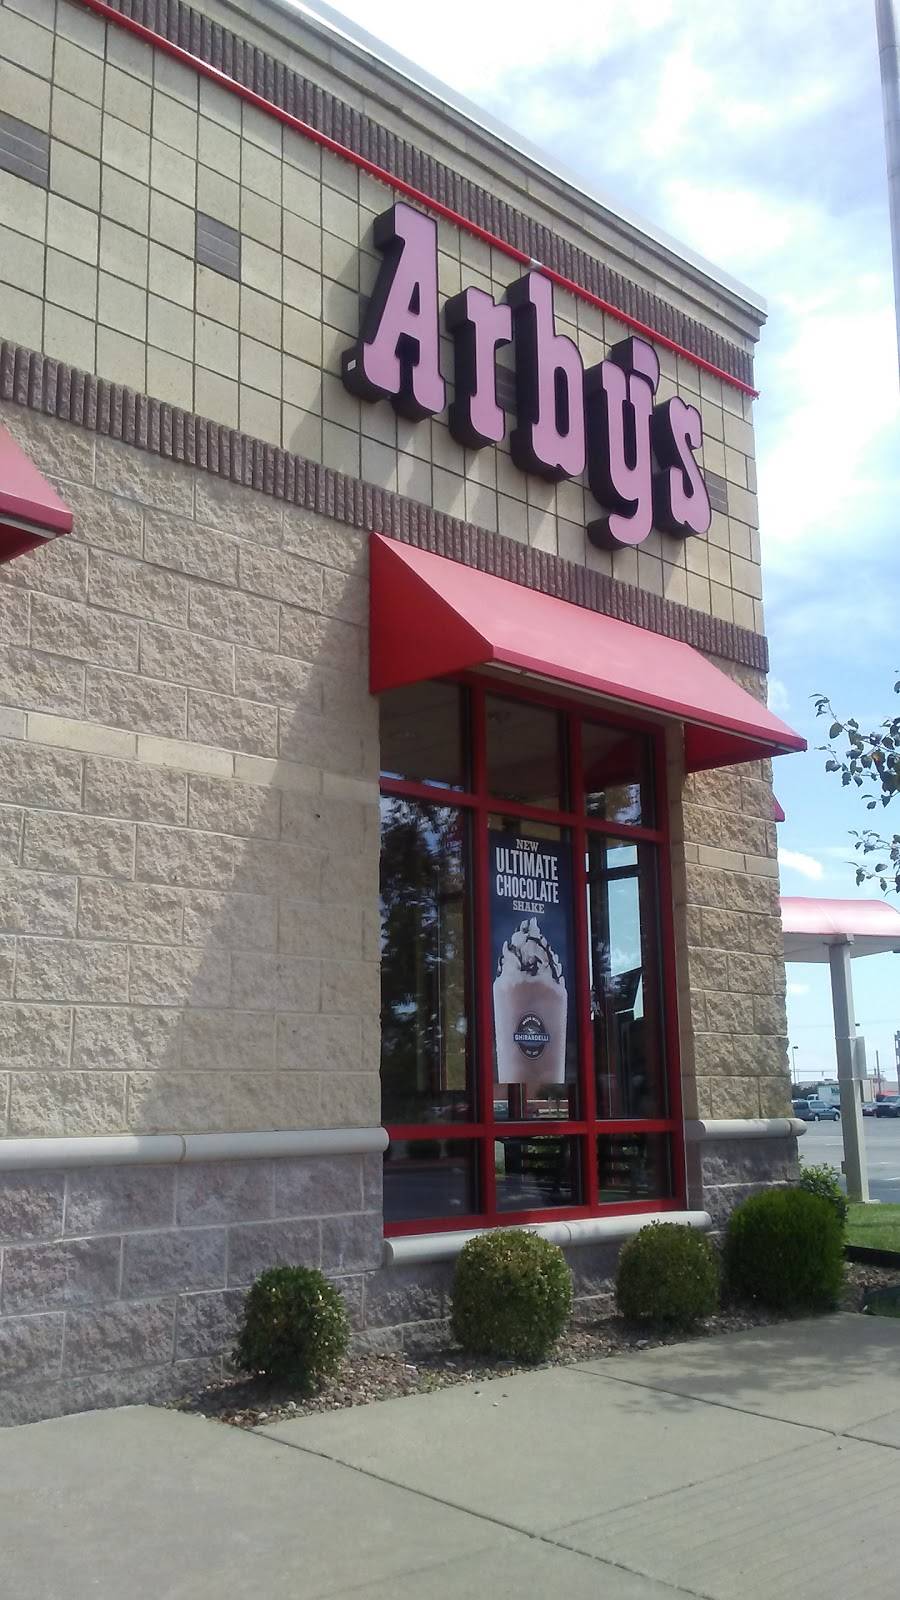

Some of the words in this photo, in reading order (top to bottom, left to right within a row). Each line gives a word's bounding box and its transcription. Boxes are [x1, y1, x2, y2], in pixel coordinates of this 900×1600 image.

[360, 201, 712, 545] Arby's
[516, 839, 539, 851] NEW
[496, 847, 558, 880] ULTIMATE
[496, 874, 559, 903] CHOCOLATE
[513, 900, 545, 914] SHAKE
